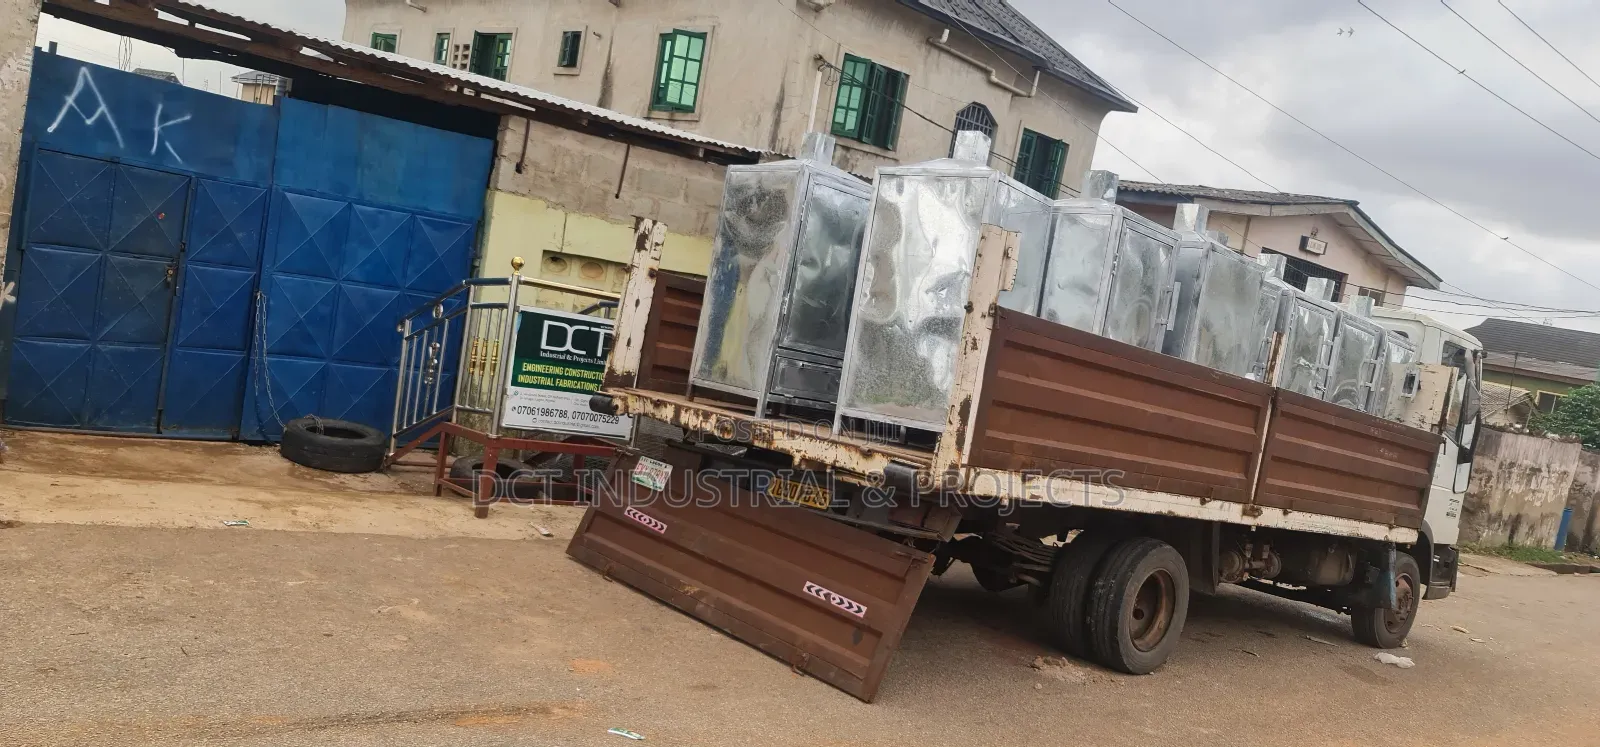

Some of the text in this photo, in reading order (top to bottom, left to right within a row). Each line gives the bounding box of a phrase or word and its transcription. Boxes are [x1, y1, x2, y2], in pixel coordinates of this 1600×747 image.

[151, 103, 192, 165] K
[541, 320, 614, 357] DCT
[540, 350, 566, 360] Industrial
[573, 356, 593, 364] Projects
[522, 362, 564, 376] ENGINEERING
[518, 375, 554, 386] INDUSTRIAL
[555, 378, 598, 392] FABRICATIONS
[571, 410, 620, 425] 07070075229
